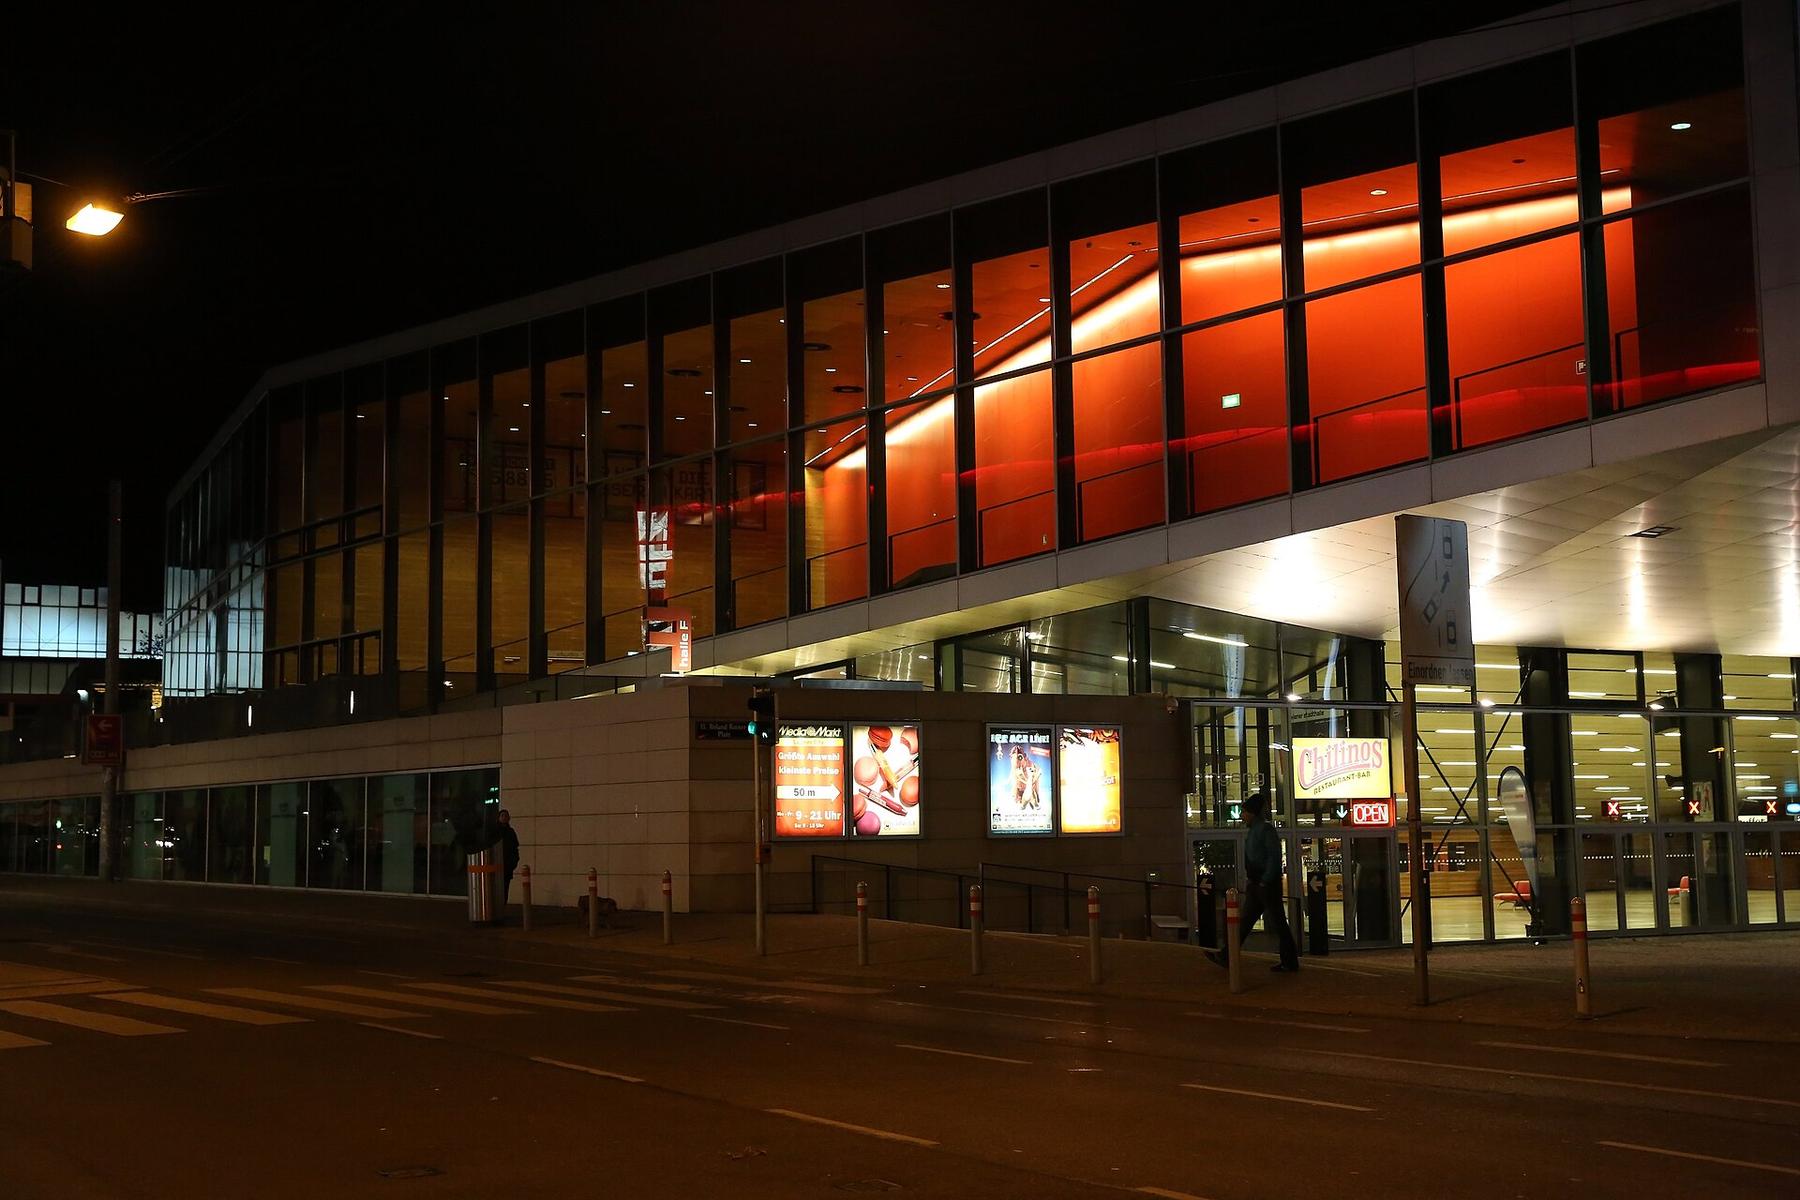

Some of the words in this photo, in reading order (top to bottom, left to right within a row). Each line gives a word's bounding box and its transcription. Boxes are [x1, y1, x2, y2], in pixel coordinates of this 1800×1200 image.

[679, 620, 689, 630] F
[679, 633, 689, 668] halle
[779, 725, 807, 737] Media
[813, 726, 841, 737] Markt
[1298, 739, 1383, 790] Chilinos
[793, 788, 805, 797] 50
[807, 789, 816, 797] m
[795, 811, 802, 820] 9
[810, 811, 823, 820] 21
[825, 810, 842, 820] Uhr
[1355, 804, 1388, 822] OPEN
